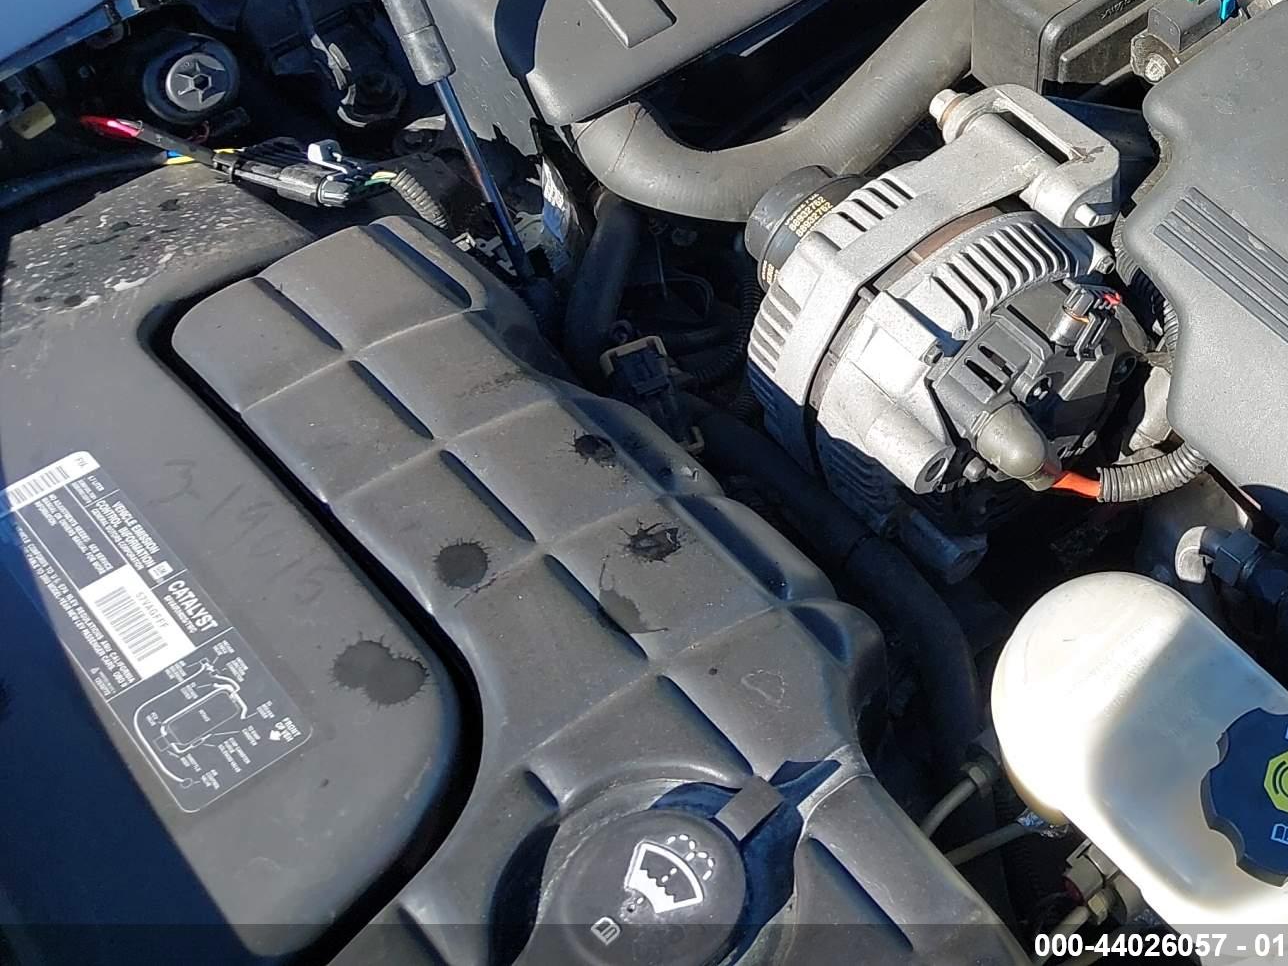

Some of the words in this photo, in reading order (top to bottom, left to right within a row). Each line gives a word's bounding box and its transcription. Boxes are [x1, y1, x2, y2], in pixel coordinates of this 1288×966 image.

[787, 195, 826, 232] 88932762
[794, 201, 833, 238] 88932762
[95, 499, 123, 528] CONTROL
[116, 524, 156, 568] INFORMATION
[111, 500, 138, 527] VEHICLE
[130, 523, 160, 554] EMISSION
[165, 577, 219, 635] CATALYST
[281, 716, 301, 738] FRONT
